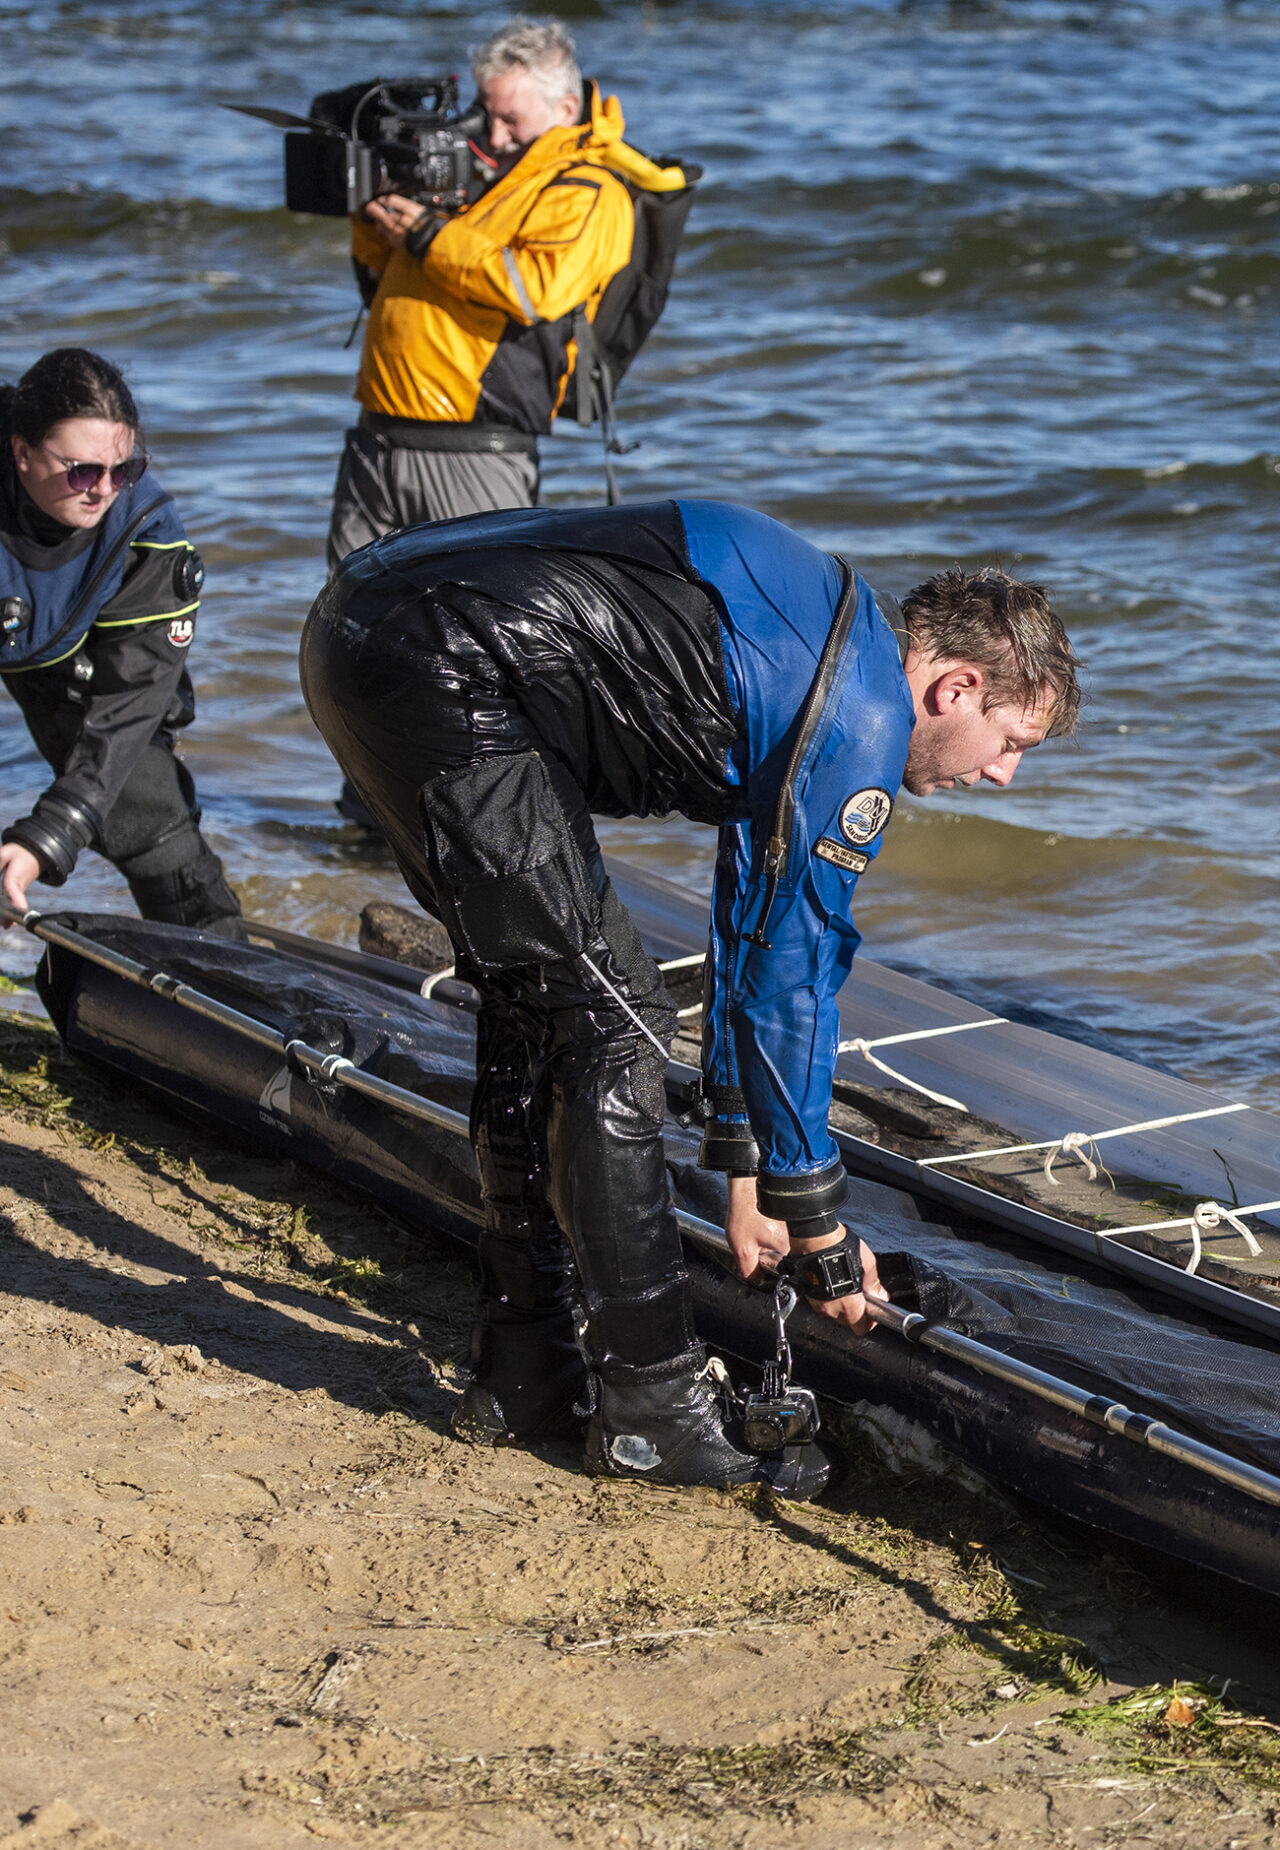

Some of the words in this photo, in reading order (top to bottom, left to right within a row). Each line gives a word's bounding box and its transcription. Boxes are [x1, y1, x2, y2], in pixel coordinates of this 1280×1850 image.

[171, 620, 193, 636] TLS
[857, 796, 888, 821] DUI
[846, 824, 856, 836] SAN
